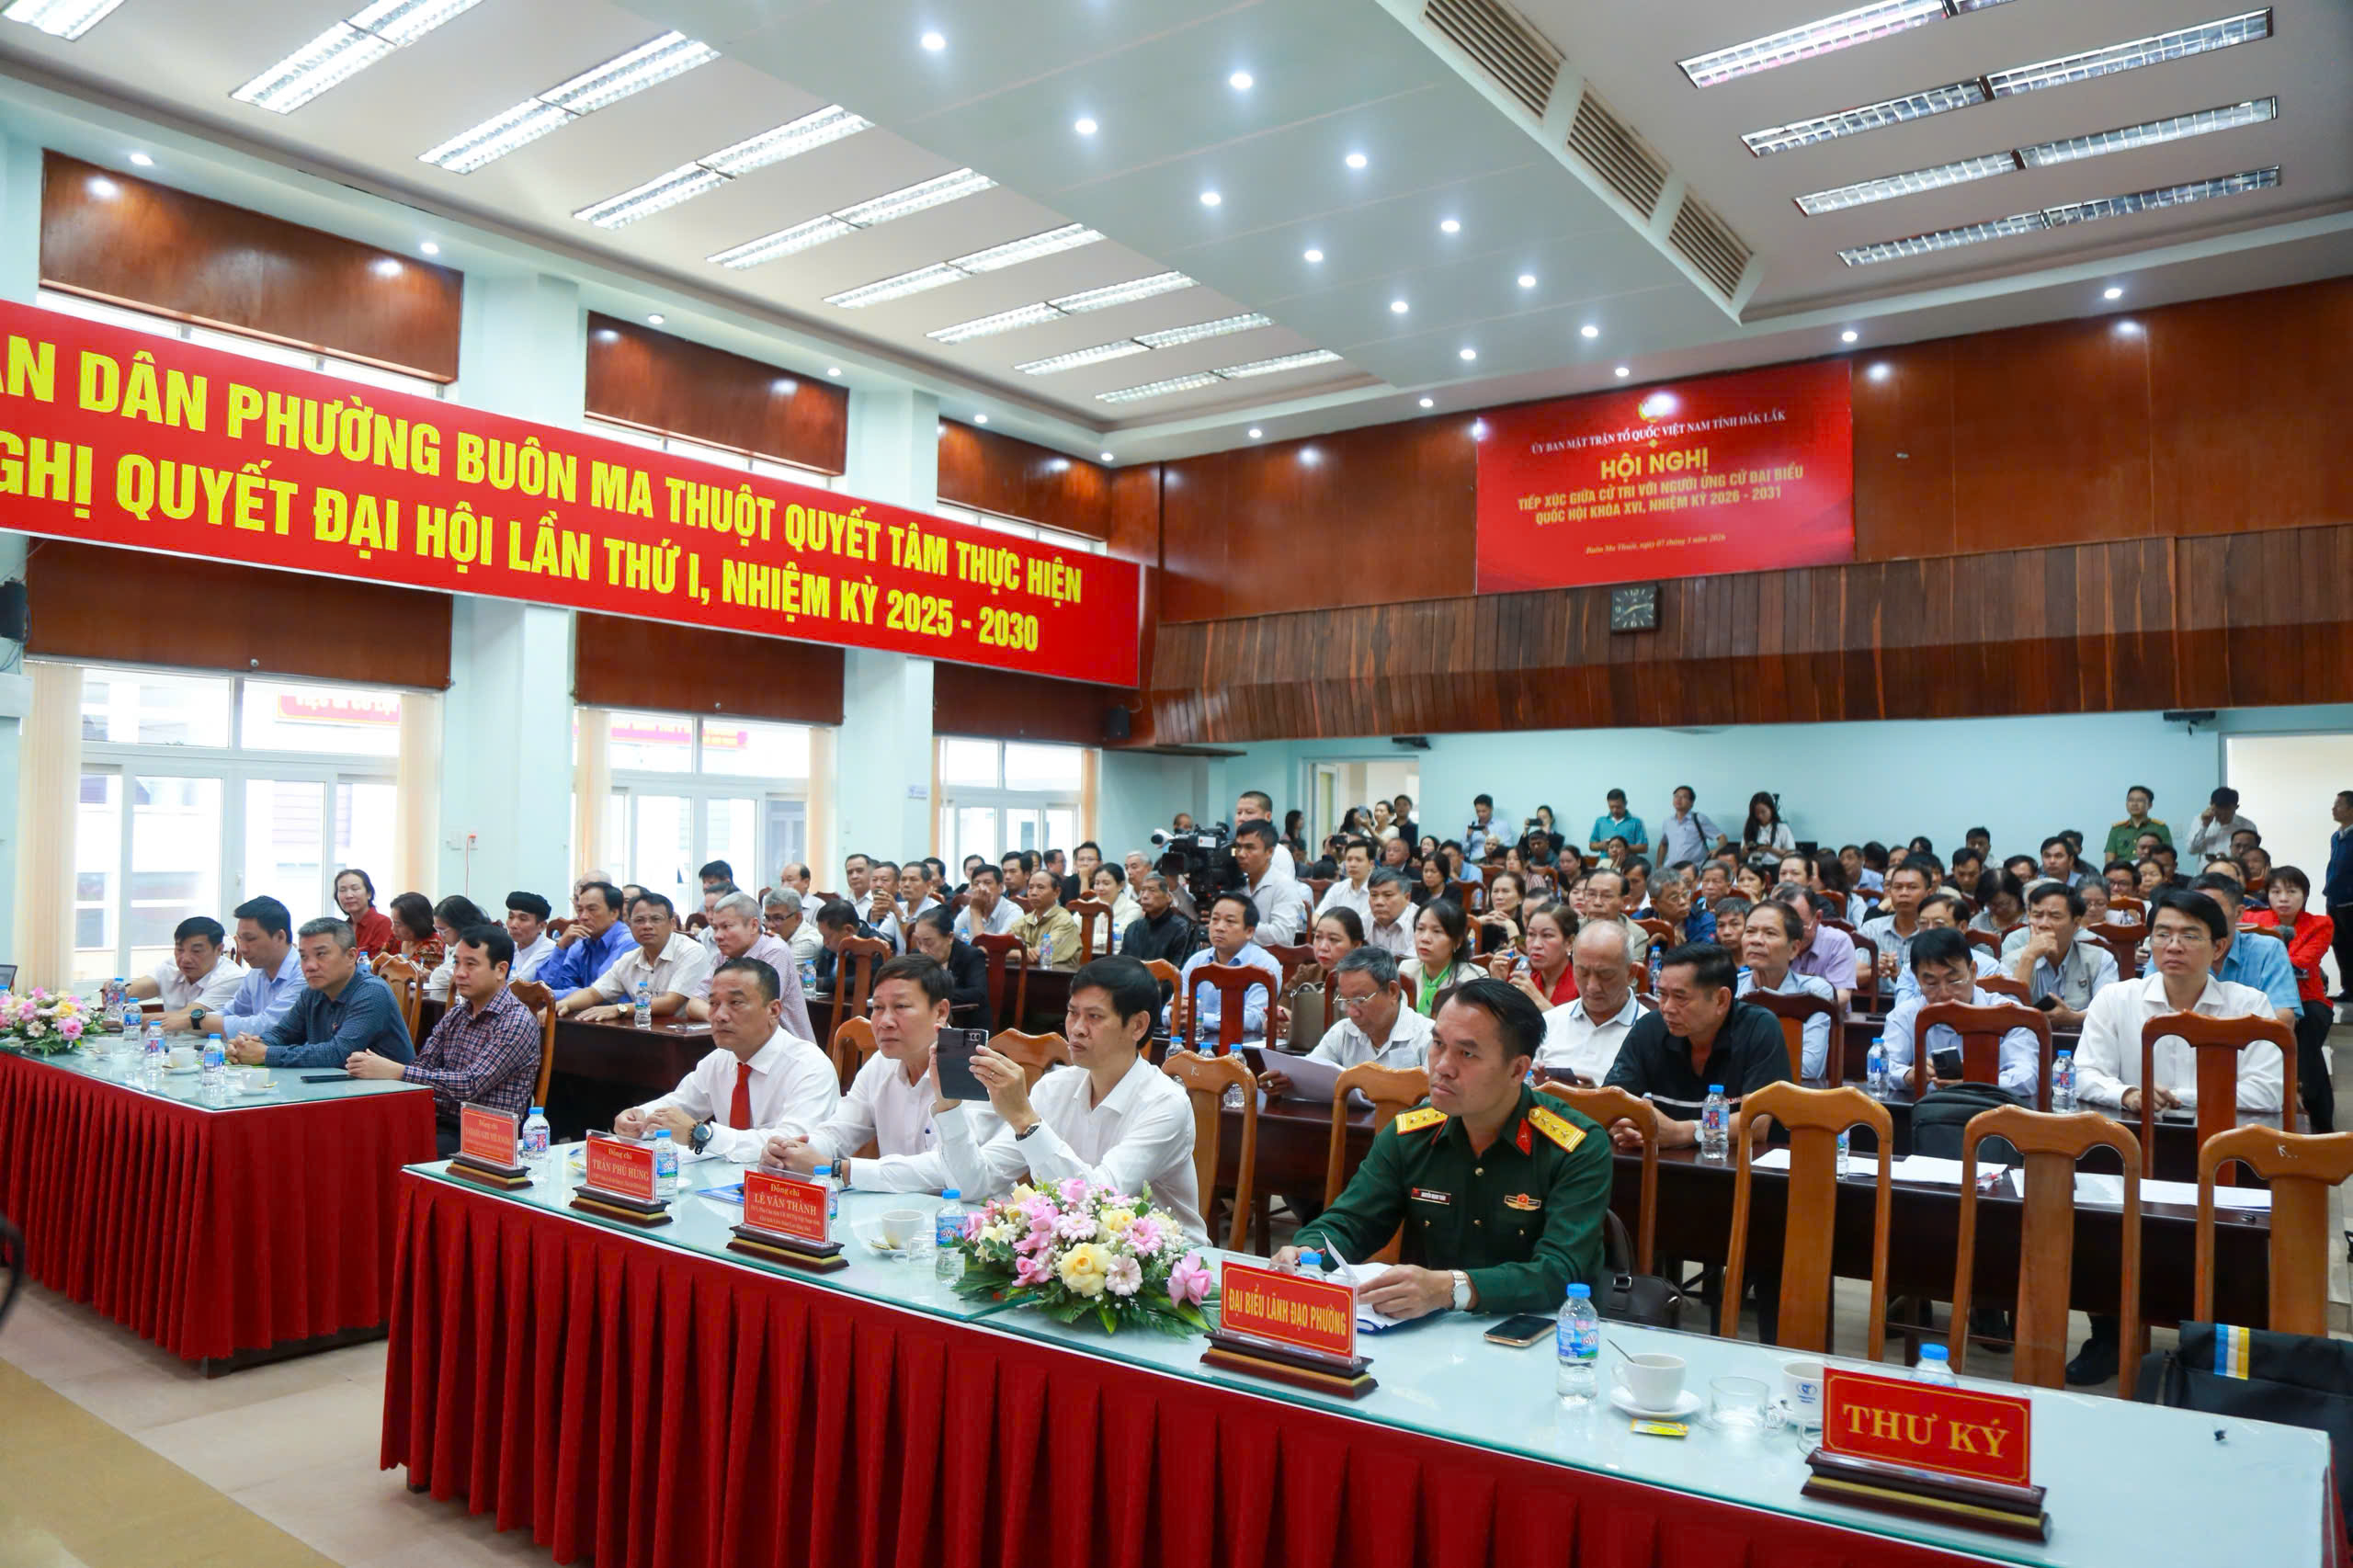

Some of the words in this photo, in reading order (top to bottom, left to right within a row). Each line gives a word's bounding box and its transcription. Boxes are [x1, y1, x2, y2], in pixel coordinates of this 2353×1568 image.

[1546, 440, 1565, 452] BAN
[1590, 434, 1615, 448] TRẬN
[1631, 425, 1660, 442] QUỐC
[1662, 424, 1685, 438] VIỆT
[1687, 420, 1711, 433] NAM
[0, 335, 55, 403] N
[79, 350, 207, 432] DÂN
[227, 382, 440, 476] PHƯỜNG
[457, 432, 577, 503] BUÔN
[591, 460, 654, 518] MA
[665, 478, 776, 546] THUỘT
[786, 505, 881, 562] QUYẾT
[888, 522, 948, 575] TÂM
[956, 541, 1020, 594] THỰC
[1028, 557, 1082, 607] HIỆN
[1518, 494, 1540, 509] TIẾP
[1544, 493, 1566, 507] XÚC
[1570, 488, 1596, 505] GIỮA
[1618, 485, 1635, 498] TRI
[1638, 480, 1657, 496] VỚI
[1661, 475, 1698, 494] NGƯỜI
[1749, 469, 1770, 485] ĐẠI
[1774, 461, 1803, 481] BIỂU
[1600, 452, 1642, 483] HỘI
[1649, 448, 1709, 473] NGHỊ
[1536, 509, 1565, 525] QUỐC
[1568, 506, 1587, 521] HỘI
[1590, 503, 1620, 518] KHÓA
[1624, 501, 1646, 515] XVI,
[1650, 494, 1688, 513] NHIỆM
[1691, 492, 1707, 507] KỲ
[1711, 489, 1740, 505] 2026
[1752, 485, 1781, 501] 2031
[117, 454, 298, 535] QUYẾT
[313, 487, 400, 559] ĐẠI
[416, 501, 494, 574] HỘI
[509, 510, 590, 580] LẦN
[604, 537, 680, 594] THỨ
[689, 553, 710, 606] I,
[722, 559, 830, 621] NHIỆM
[841, 575, 879, 624] KỲ
[887, 590, 953, 637] 2025
[961, 619, 972, 628] -
[979, 607, 1039, 651] 2030
[755, 1192, 766, 1205] LÊ
[767, 1195, 785, 1209] VĂN
[786, 1199, 816, 1216] THÀNH
[1229, 1289, 1243, 1317] ĐẠI
[1245, 1283, 1265, 1317] BIỂU
[1267, 1291, 1289, 1324] LÃNH
[1290, 1301, 1309, 1331] ĐẠO
[1311, 1303, 1347, 1336] PHƯỜNG
[1842, 1403, 1939, 1445] THƯ
[1948, 1418, 2011, 1459] KÝ
